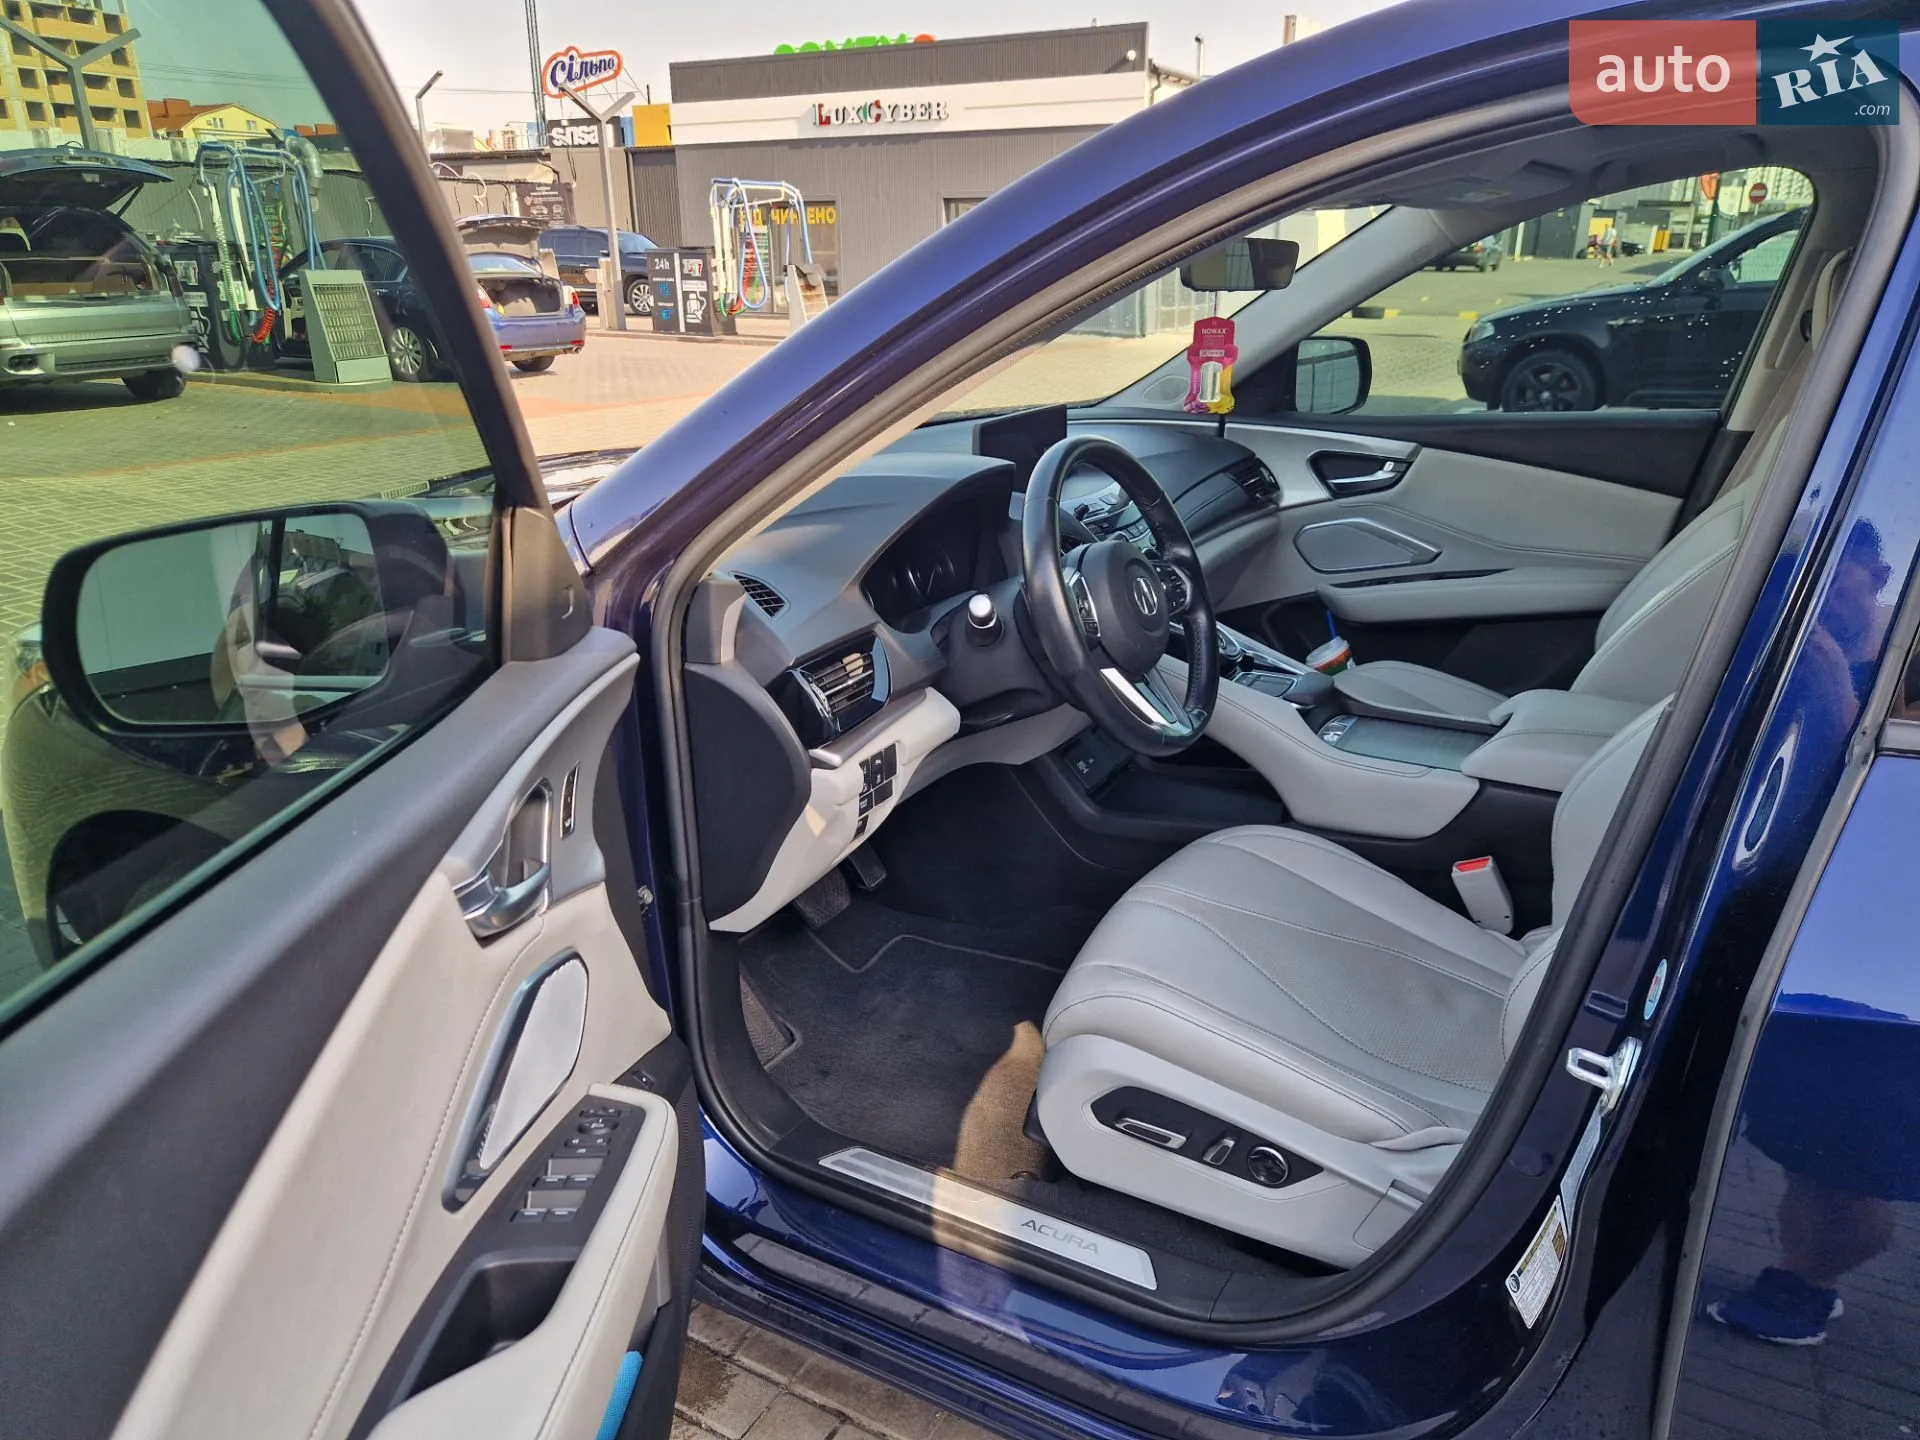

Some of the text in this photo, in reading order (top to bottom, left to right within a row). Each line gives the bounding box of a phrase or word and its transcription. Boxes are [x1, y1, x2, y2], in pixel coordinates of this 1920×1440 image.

[551, 54, 615, 88] Сільпо
[654, 258, 671, 270] 24h
[1201, 327, 1227, 335] NOWAX
[1021, 1219, 1098, 1254] ACURA
